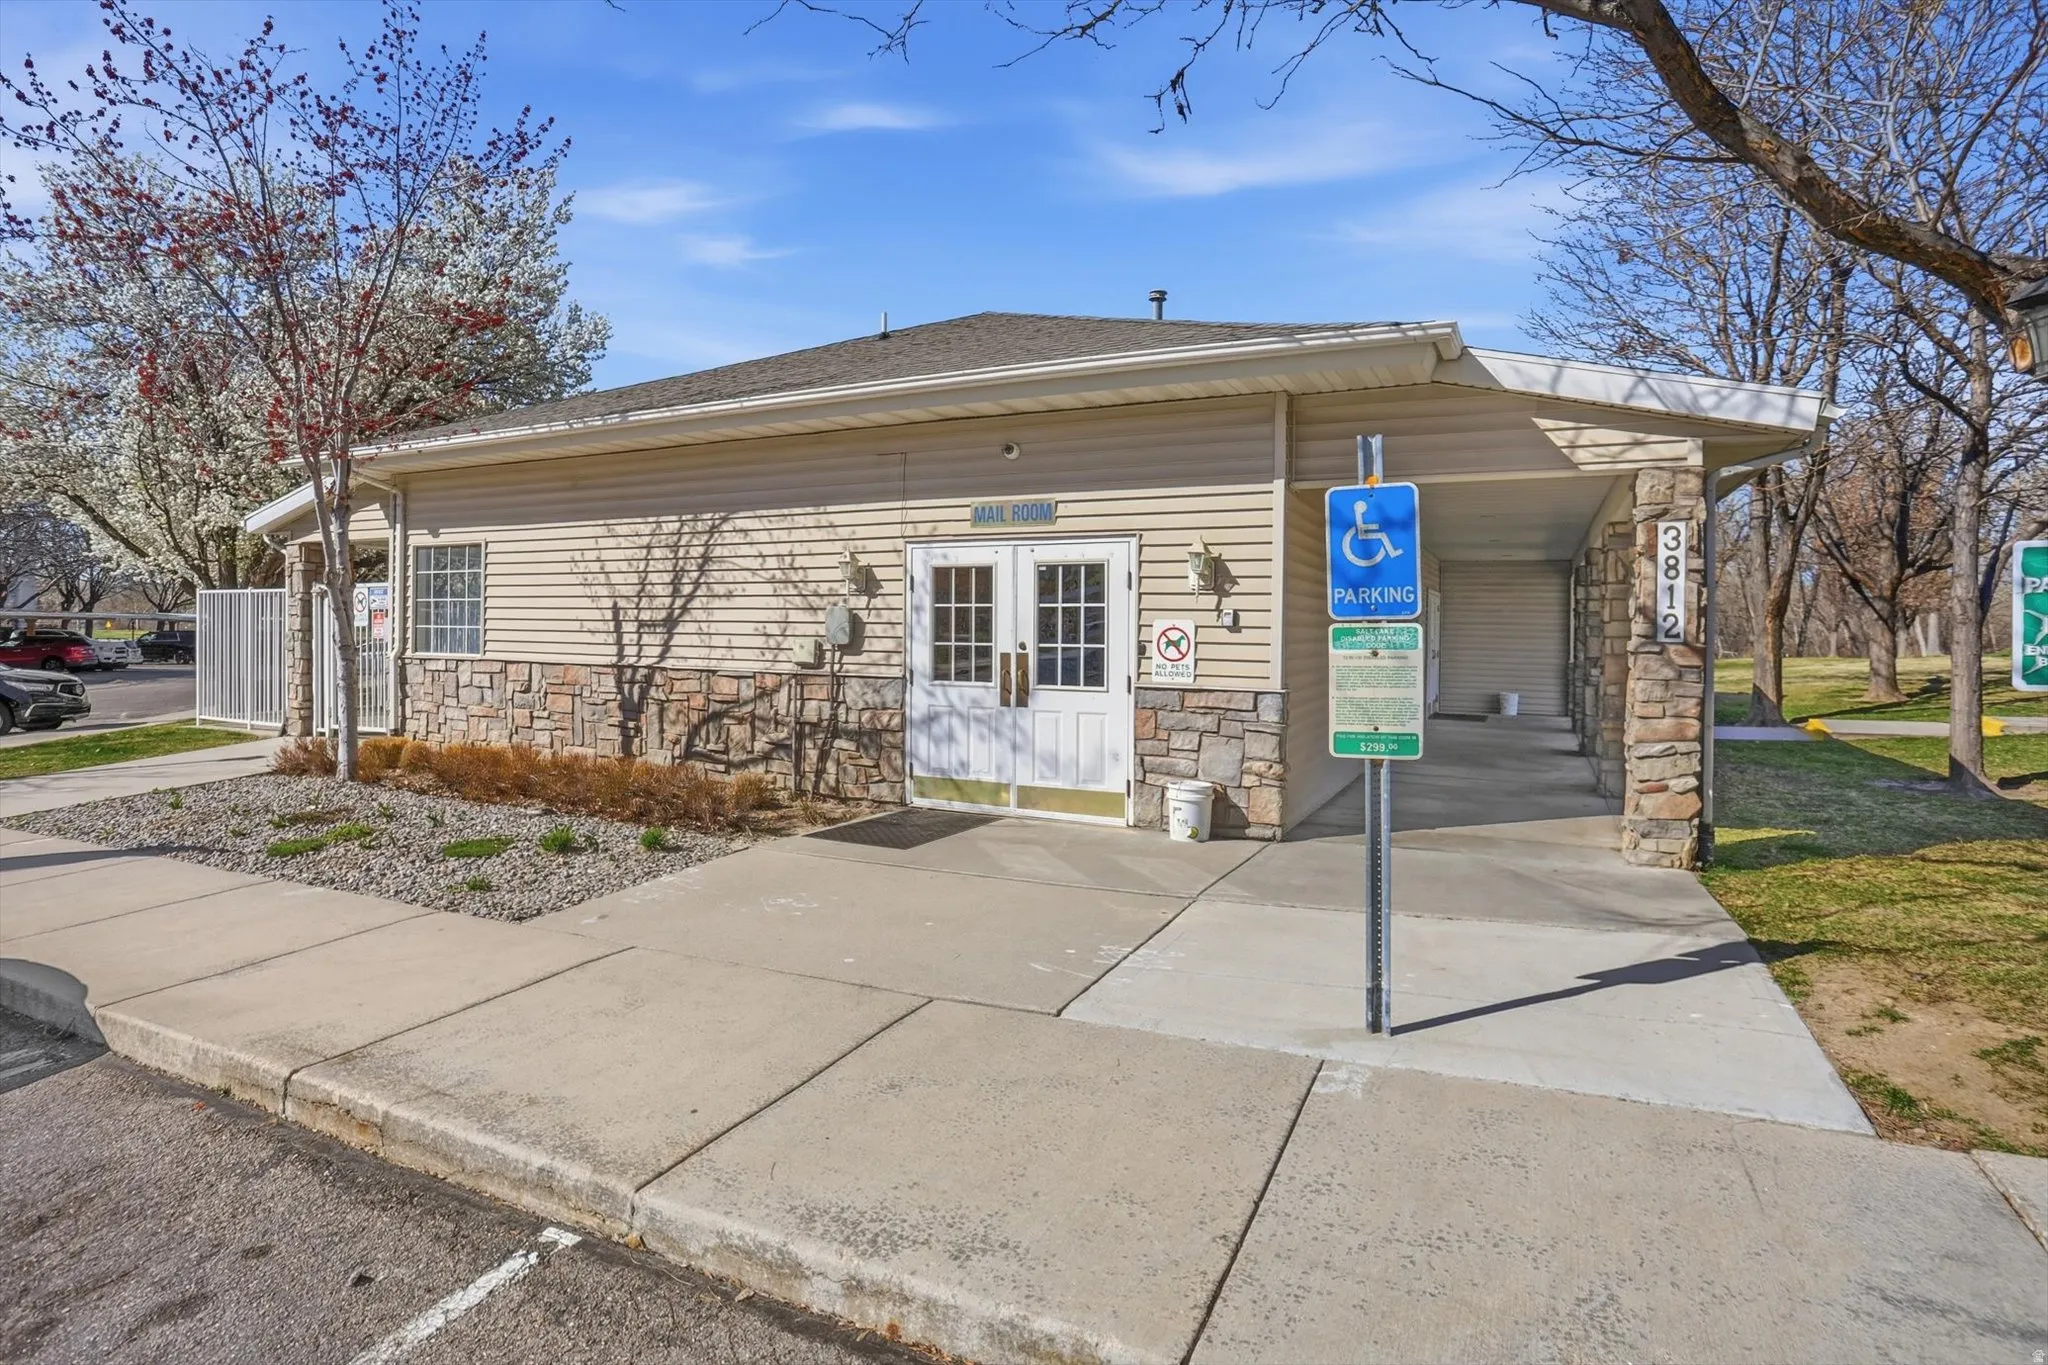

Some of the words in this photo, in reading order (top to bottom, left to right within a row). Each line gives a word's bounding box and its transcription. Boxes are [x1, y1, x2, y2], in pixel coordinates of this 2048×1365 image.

[974, 505, 1006, 523] MAIL
[1012, 503, 1052, 521] ROOM
[1662, 525, 1681, 639] 3812
[1334, 586, 1415, 605] PARKING
[1154, 670, 1192, 678] ALLOWED
